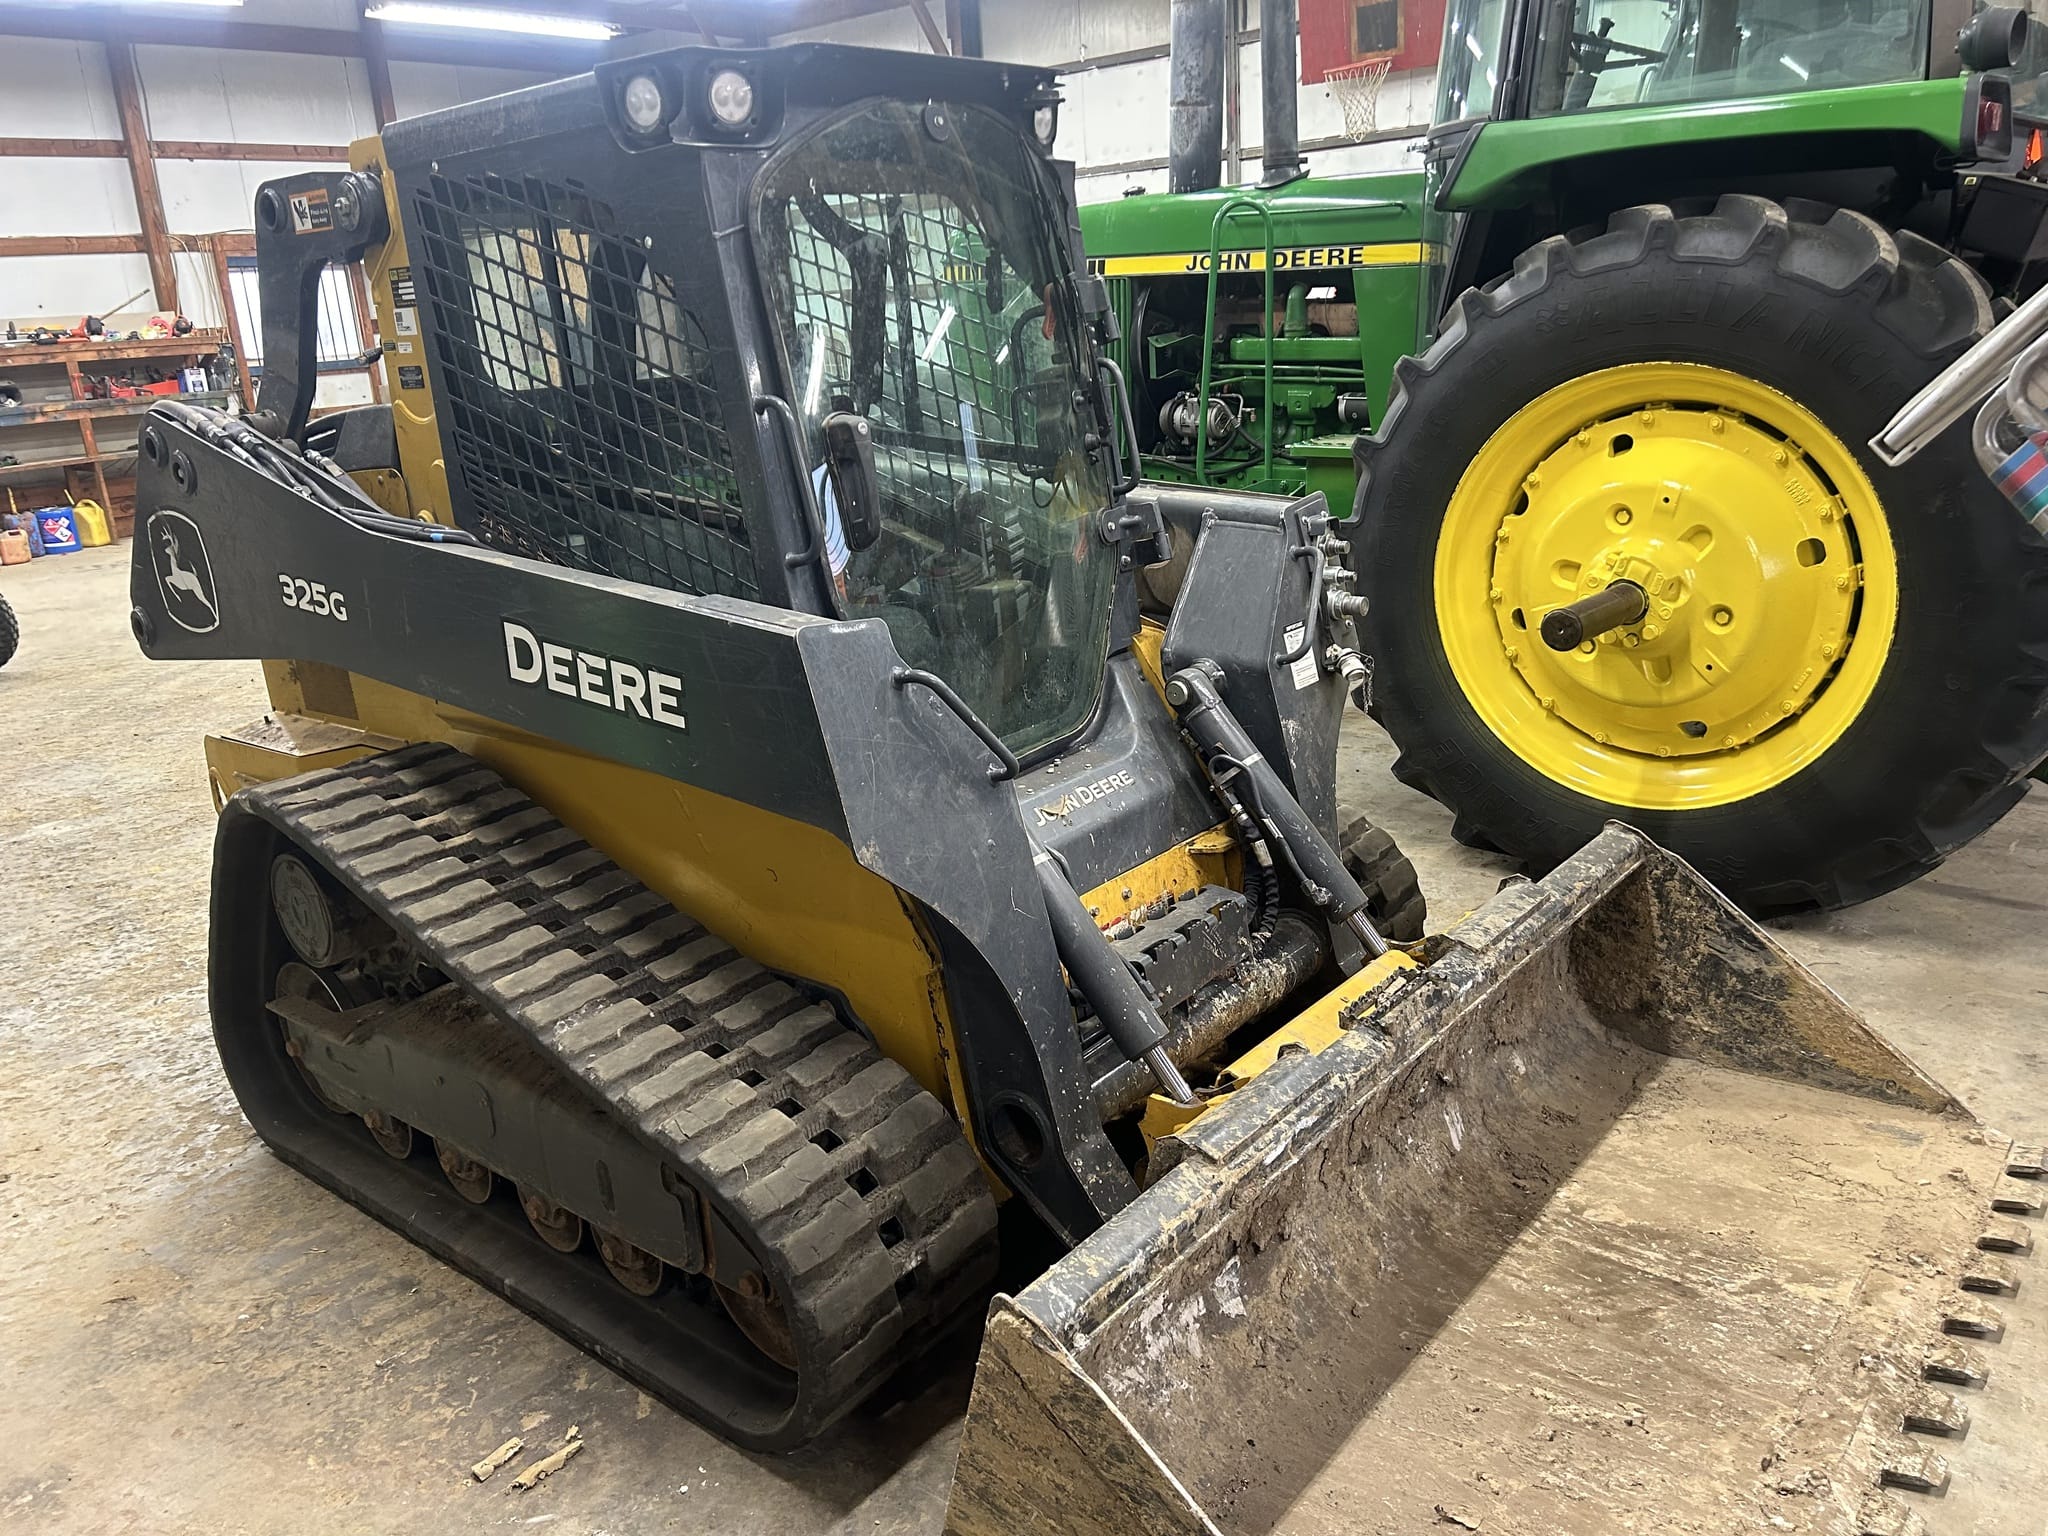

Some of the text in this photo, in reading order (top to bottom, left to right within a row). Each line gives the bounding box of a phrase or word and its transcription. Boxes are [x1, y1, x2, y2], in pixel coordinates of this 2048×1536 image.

[1186, 247, 1364, 271] JOHN DEERE
[279, 574, 348, 621] 325G
[503, 621, 686, 729] DEERE
[1075, 769, 1135, 805] DEERE
